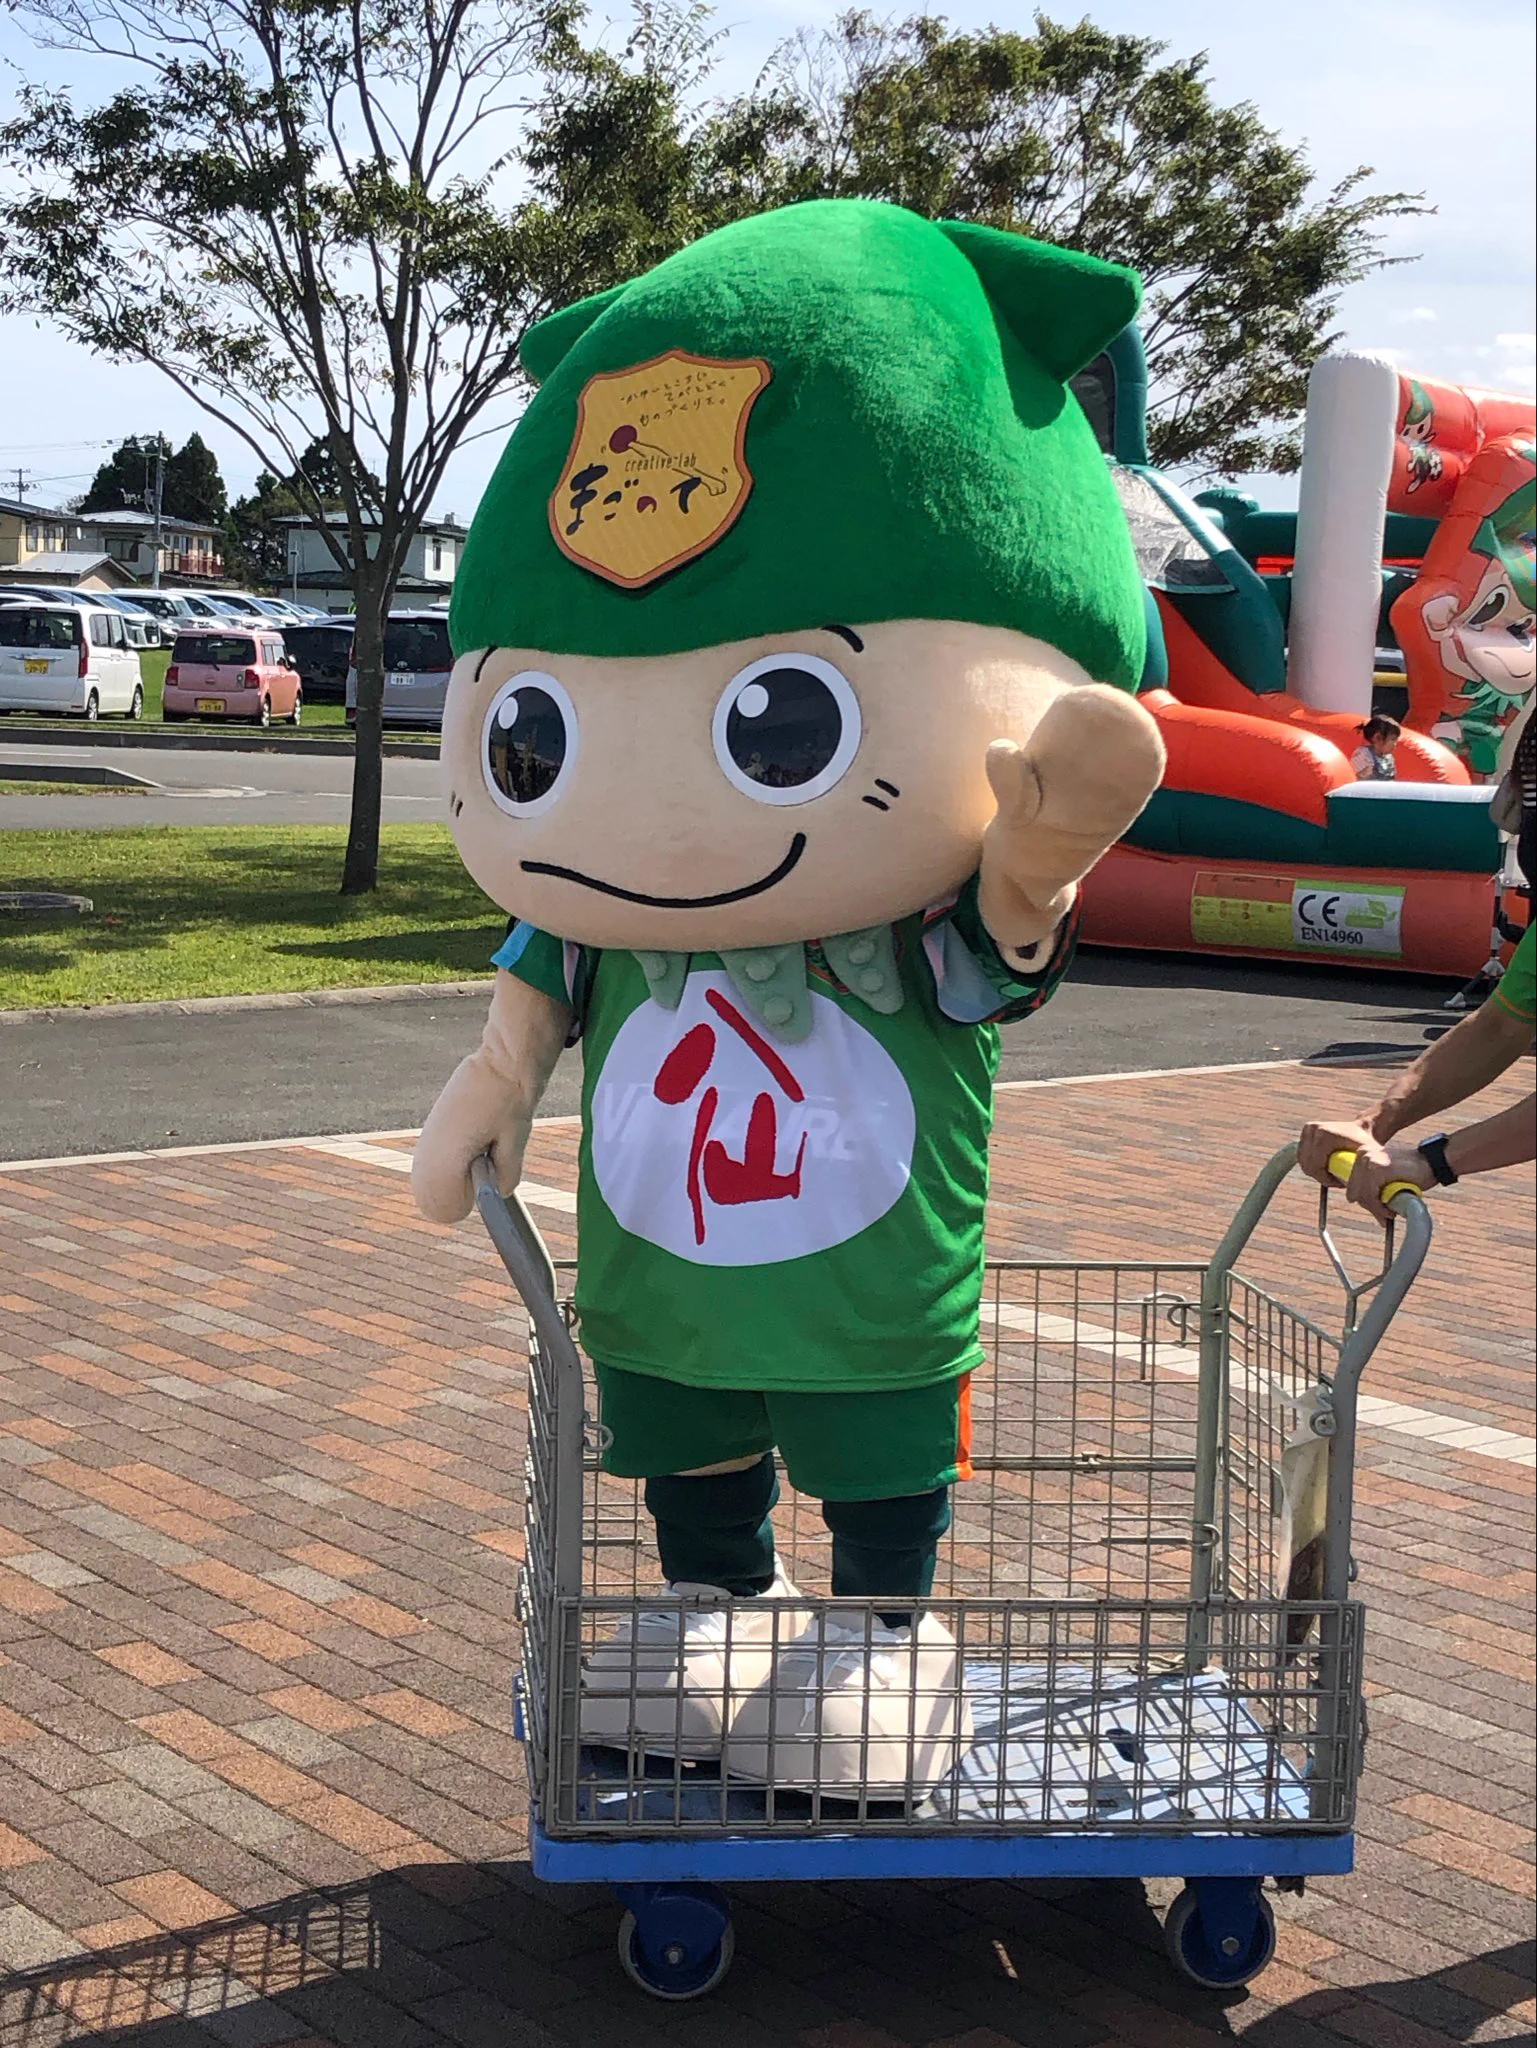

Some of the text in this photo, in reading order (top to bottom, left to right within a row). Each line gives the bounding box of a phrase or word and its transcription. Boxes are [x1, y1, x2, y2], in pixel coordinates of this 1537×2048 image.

[625, 452, 697, 472] creative-lab
[1298, 894, 1340, 928] CE
[1301, 927, 1363, 945] EN14960
